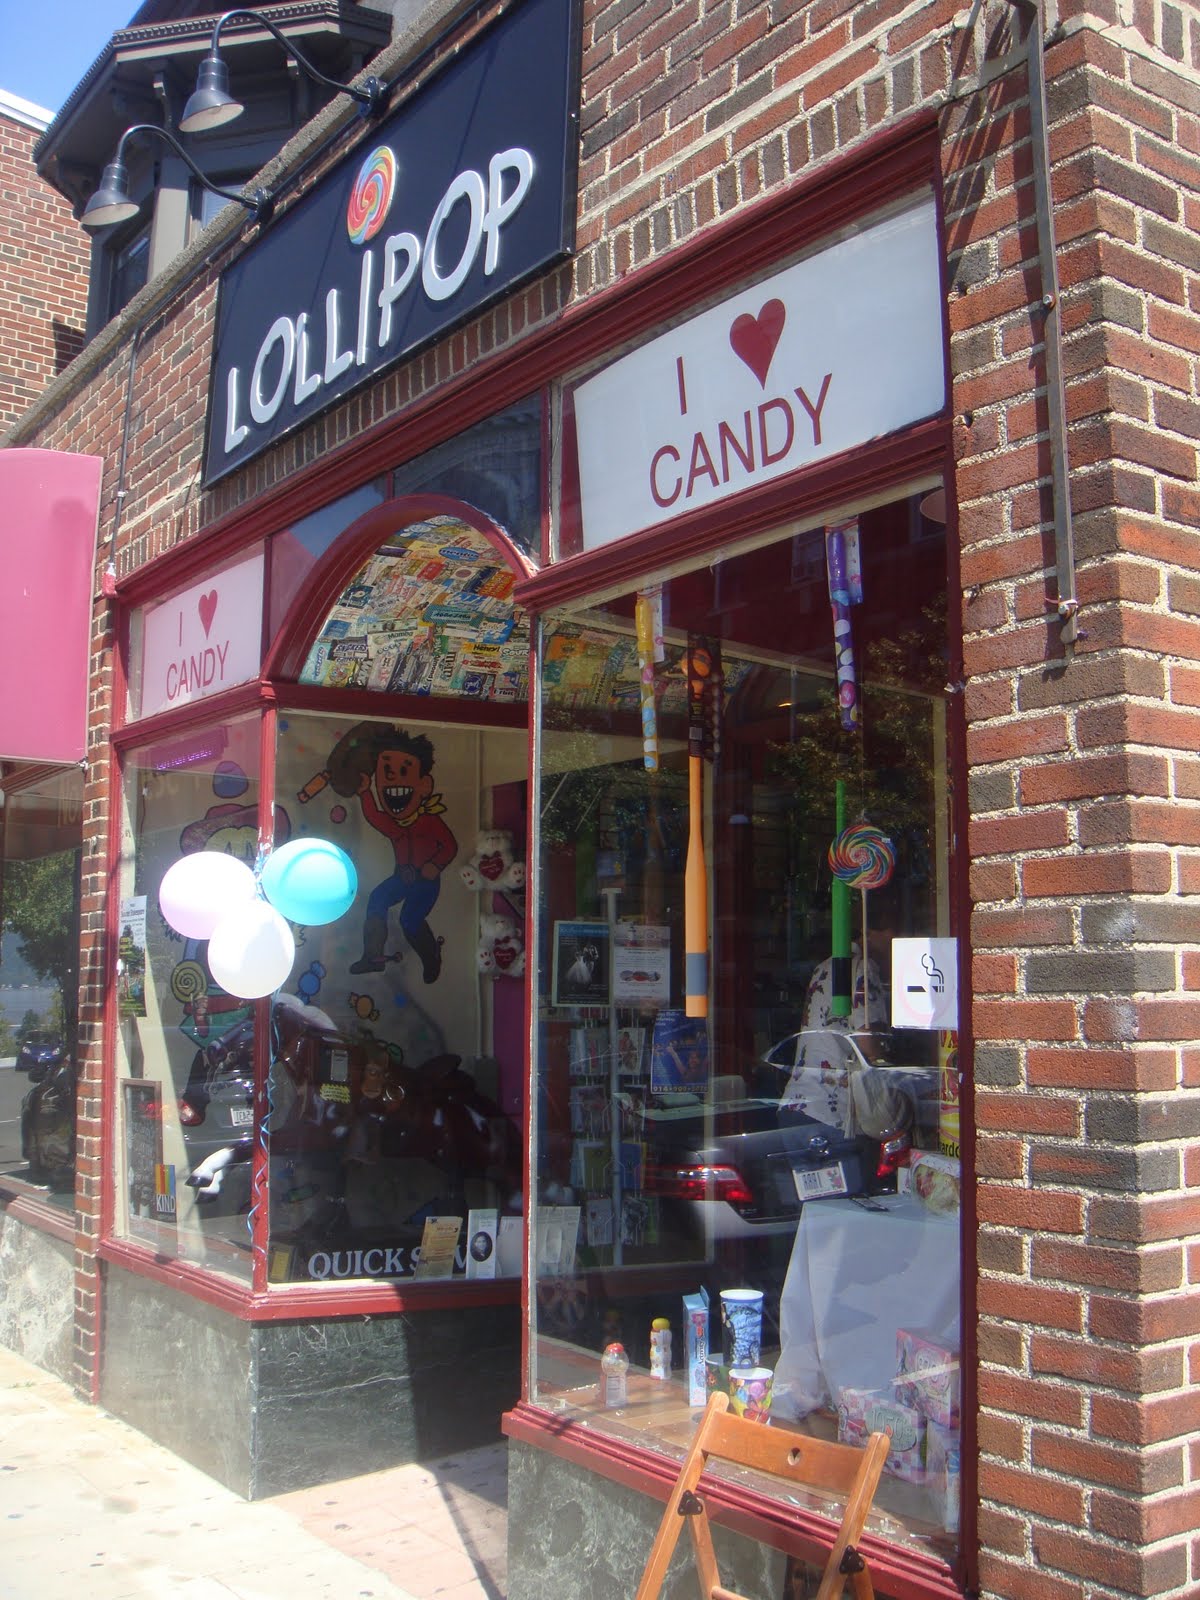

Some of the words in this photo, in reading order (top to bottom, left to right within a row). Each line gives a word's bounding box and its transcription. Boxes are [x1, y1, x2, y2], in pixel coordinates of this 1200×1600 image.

[224, 147, 534, 453] LOLLIPOP
[676, 356, 688, 416] I
[649, 373, 833, 508] CANDY
[178, 611, 183, 647] I
[166, 640, 230, 701] CANDY
[156, 1194, 176, 1213] KIND
[307, 1248, 404, 1279] QUICK
